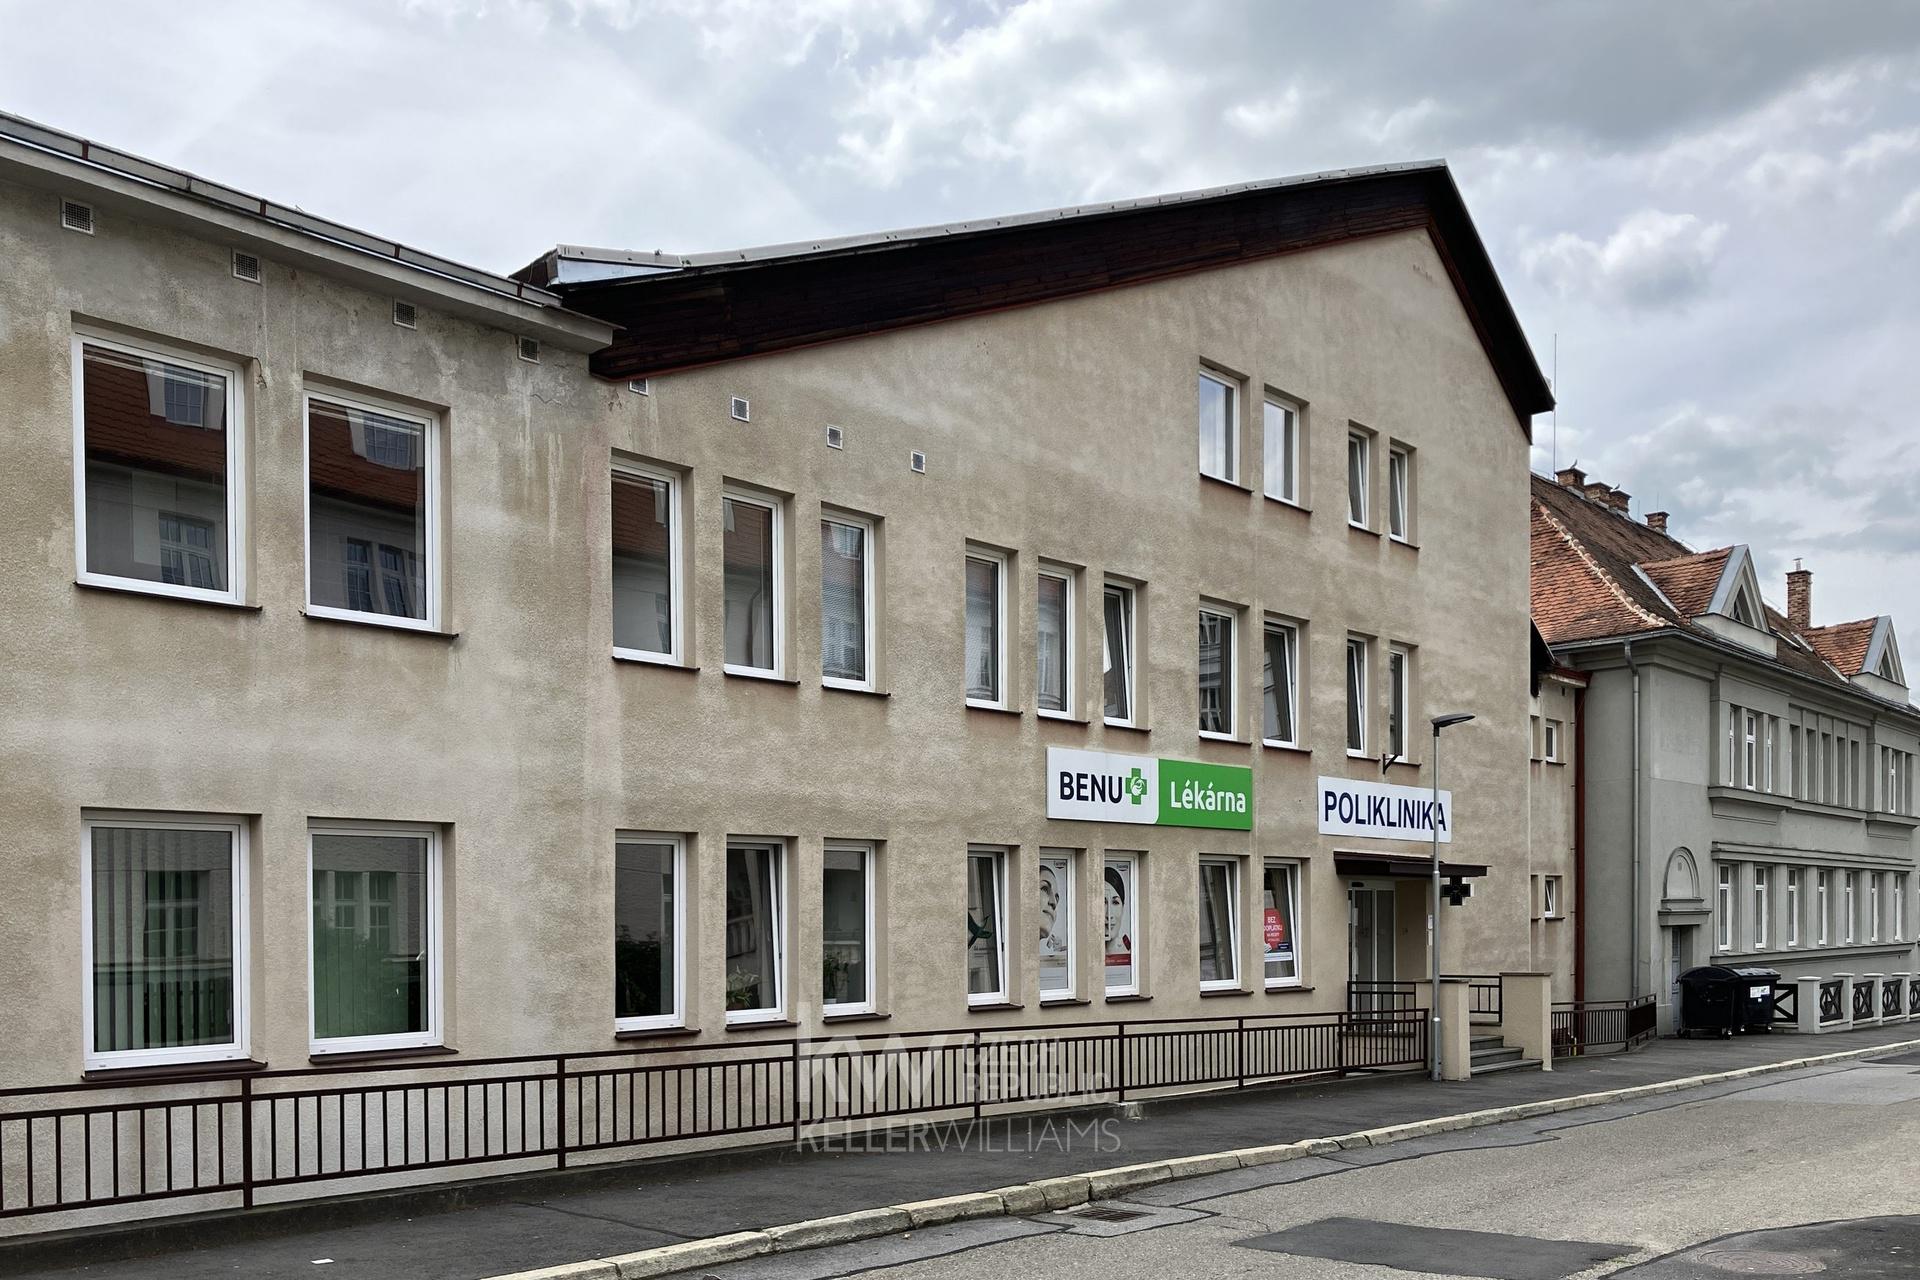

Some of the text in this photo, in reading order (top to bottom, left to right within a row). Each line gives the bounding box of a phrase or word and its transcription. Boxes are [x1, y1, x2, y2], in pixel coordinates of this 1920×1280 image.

[1060, 771, 1246, 813] BENU Lékárna
[1324, 790, 1447, 831] POLIKLINIKA
